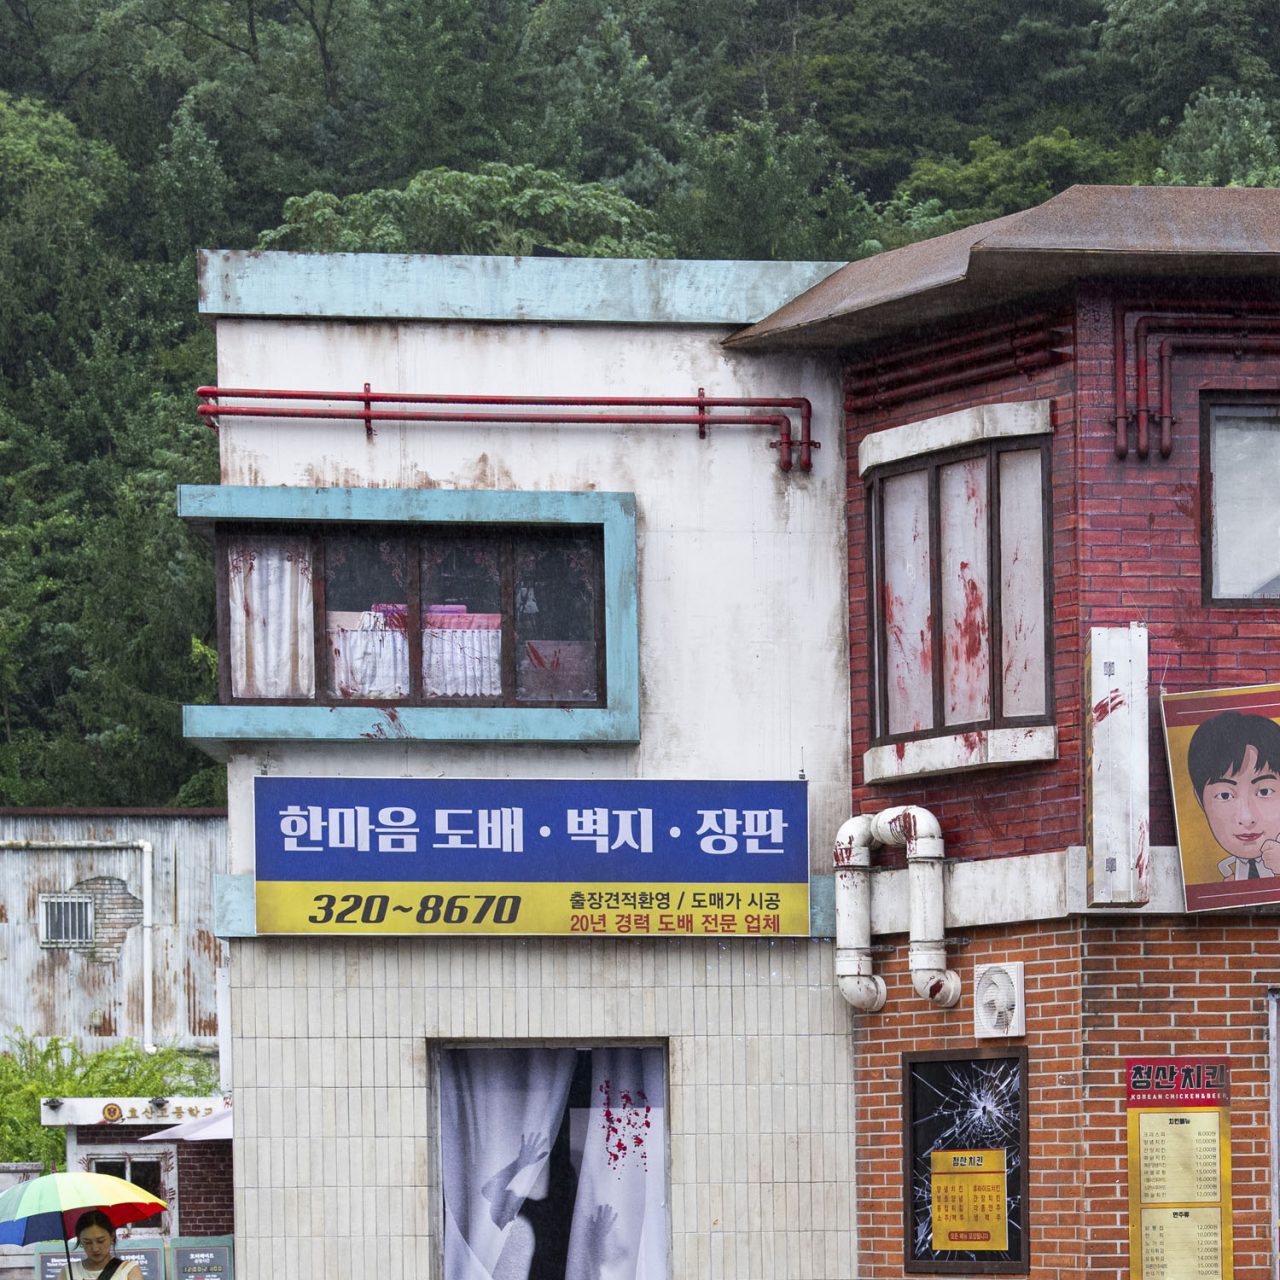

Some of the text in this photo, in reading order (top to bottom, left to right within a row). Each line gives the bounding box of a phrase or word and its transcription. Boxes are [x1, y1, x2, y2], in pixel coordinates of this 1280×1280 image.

[279, 806, 788, 854] 한마음 도배 벽지 장판
[308, 894, 521, 925] 320~8670
[570, 892, 670, 910] 출장견적환영
[691, 892, 741, 910] 도매가
[747, 892, 781, 910] 시공
[570, 914, 780, 933] 20년 경력 도배 전문 업체
[1131, 1065, 1226, 1090] 청산치킨
